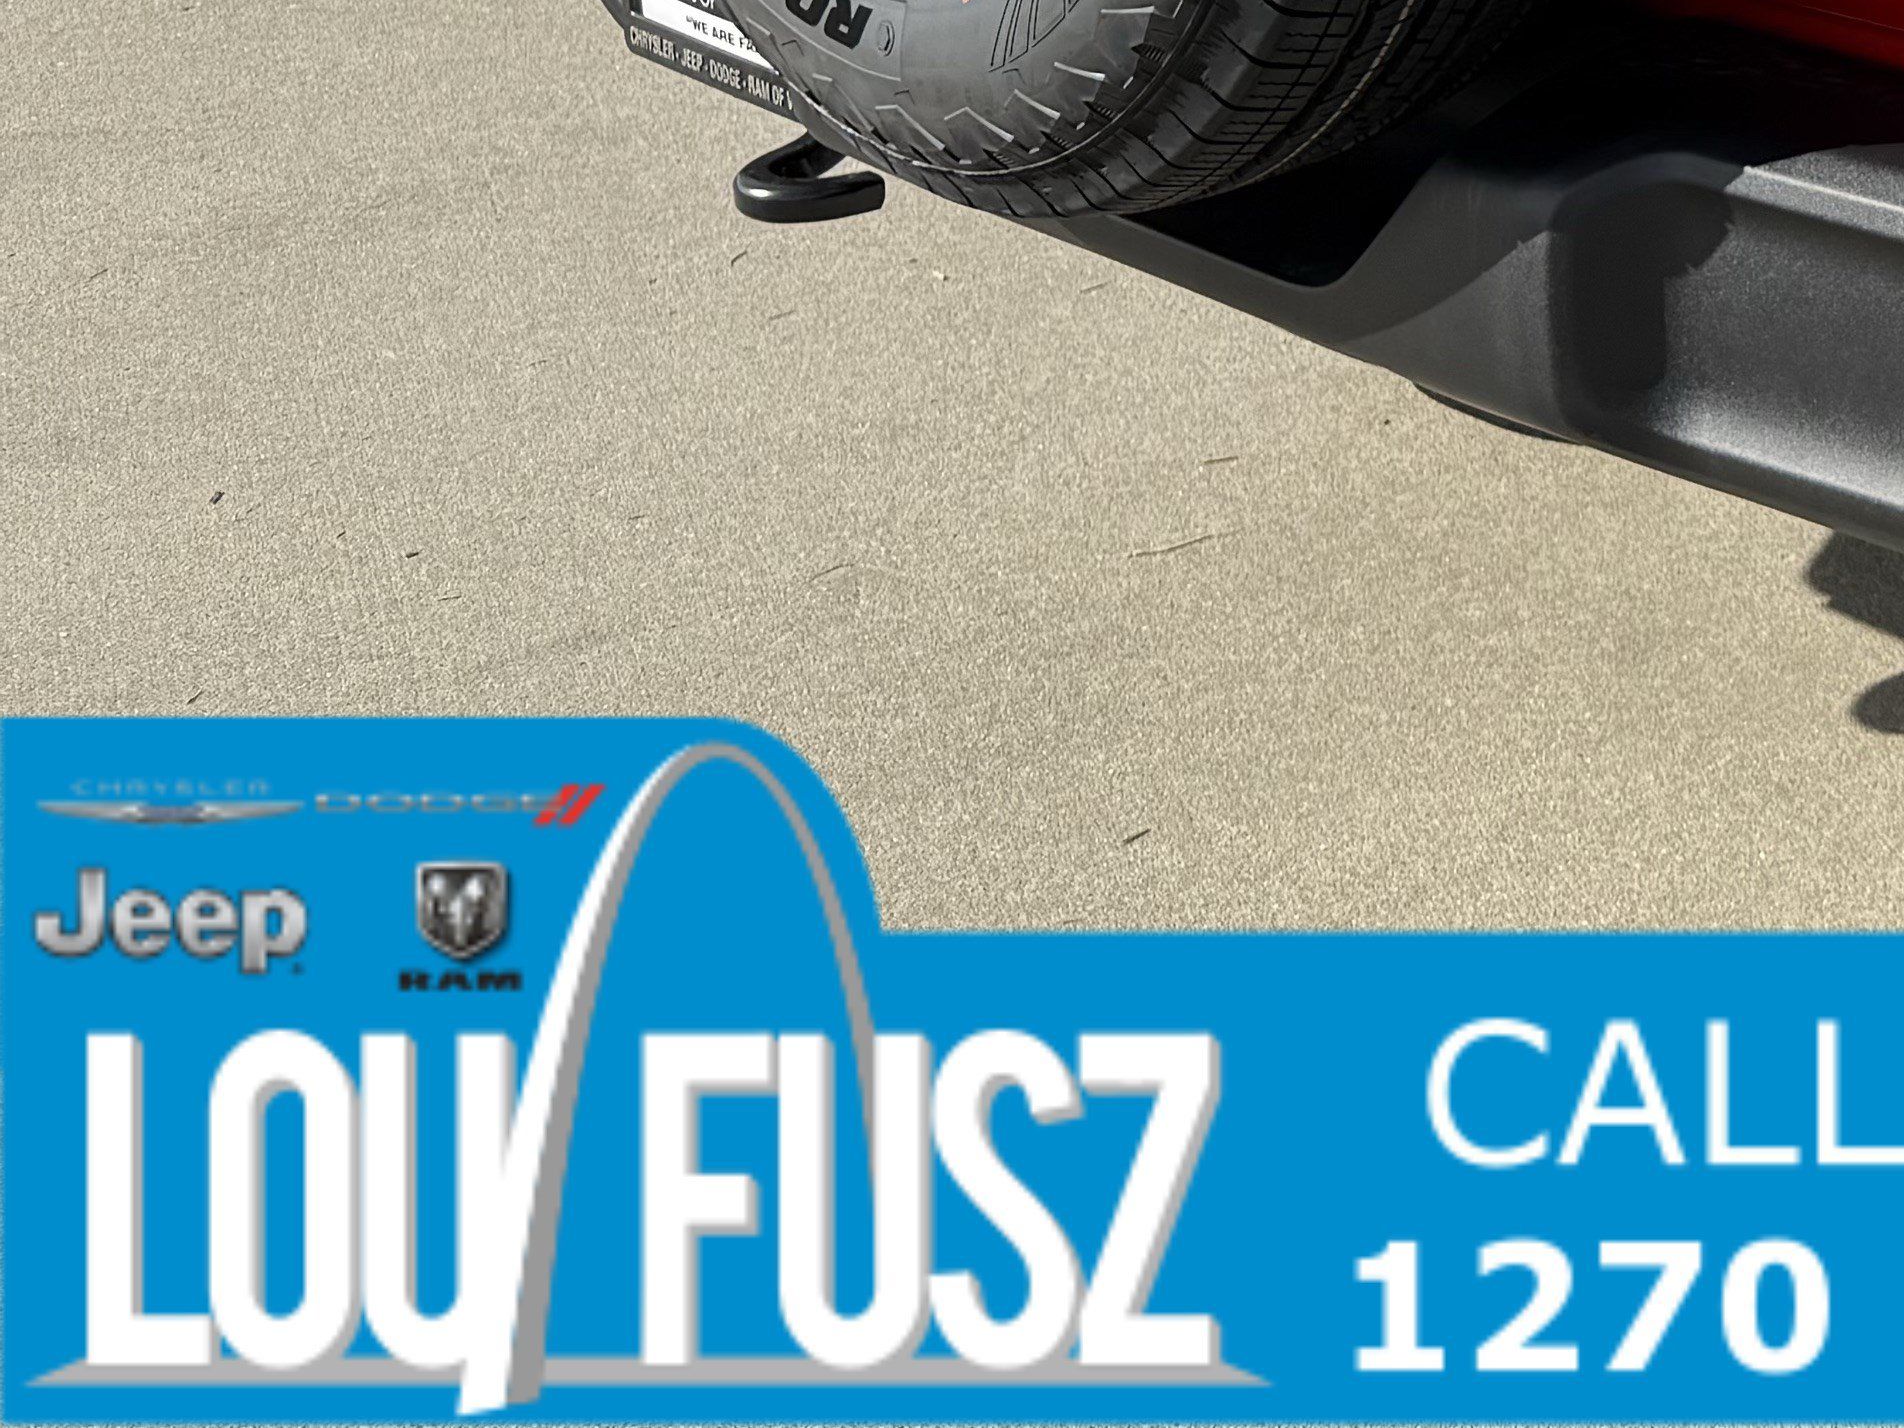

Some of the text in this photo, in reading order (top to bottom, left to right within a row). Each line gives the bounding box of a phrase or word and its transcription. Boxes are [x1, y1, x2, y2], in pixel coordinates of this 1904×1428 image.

[712, 27, 735, 45] ARE
[630, 25, 675, 61] CHRYSLER
[681, 48, 703, 72] JEEP
[709, 59, 741, 90] DODGE
[748, 74, 770, 103] RAM
